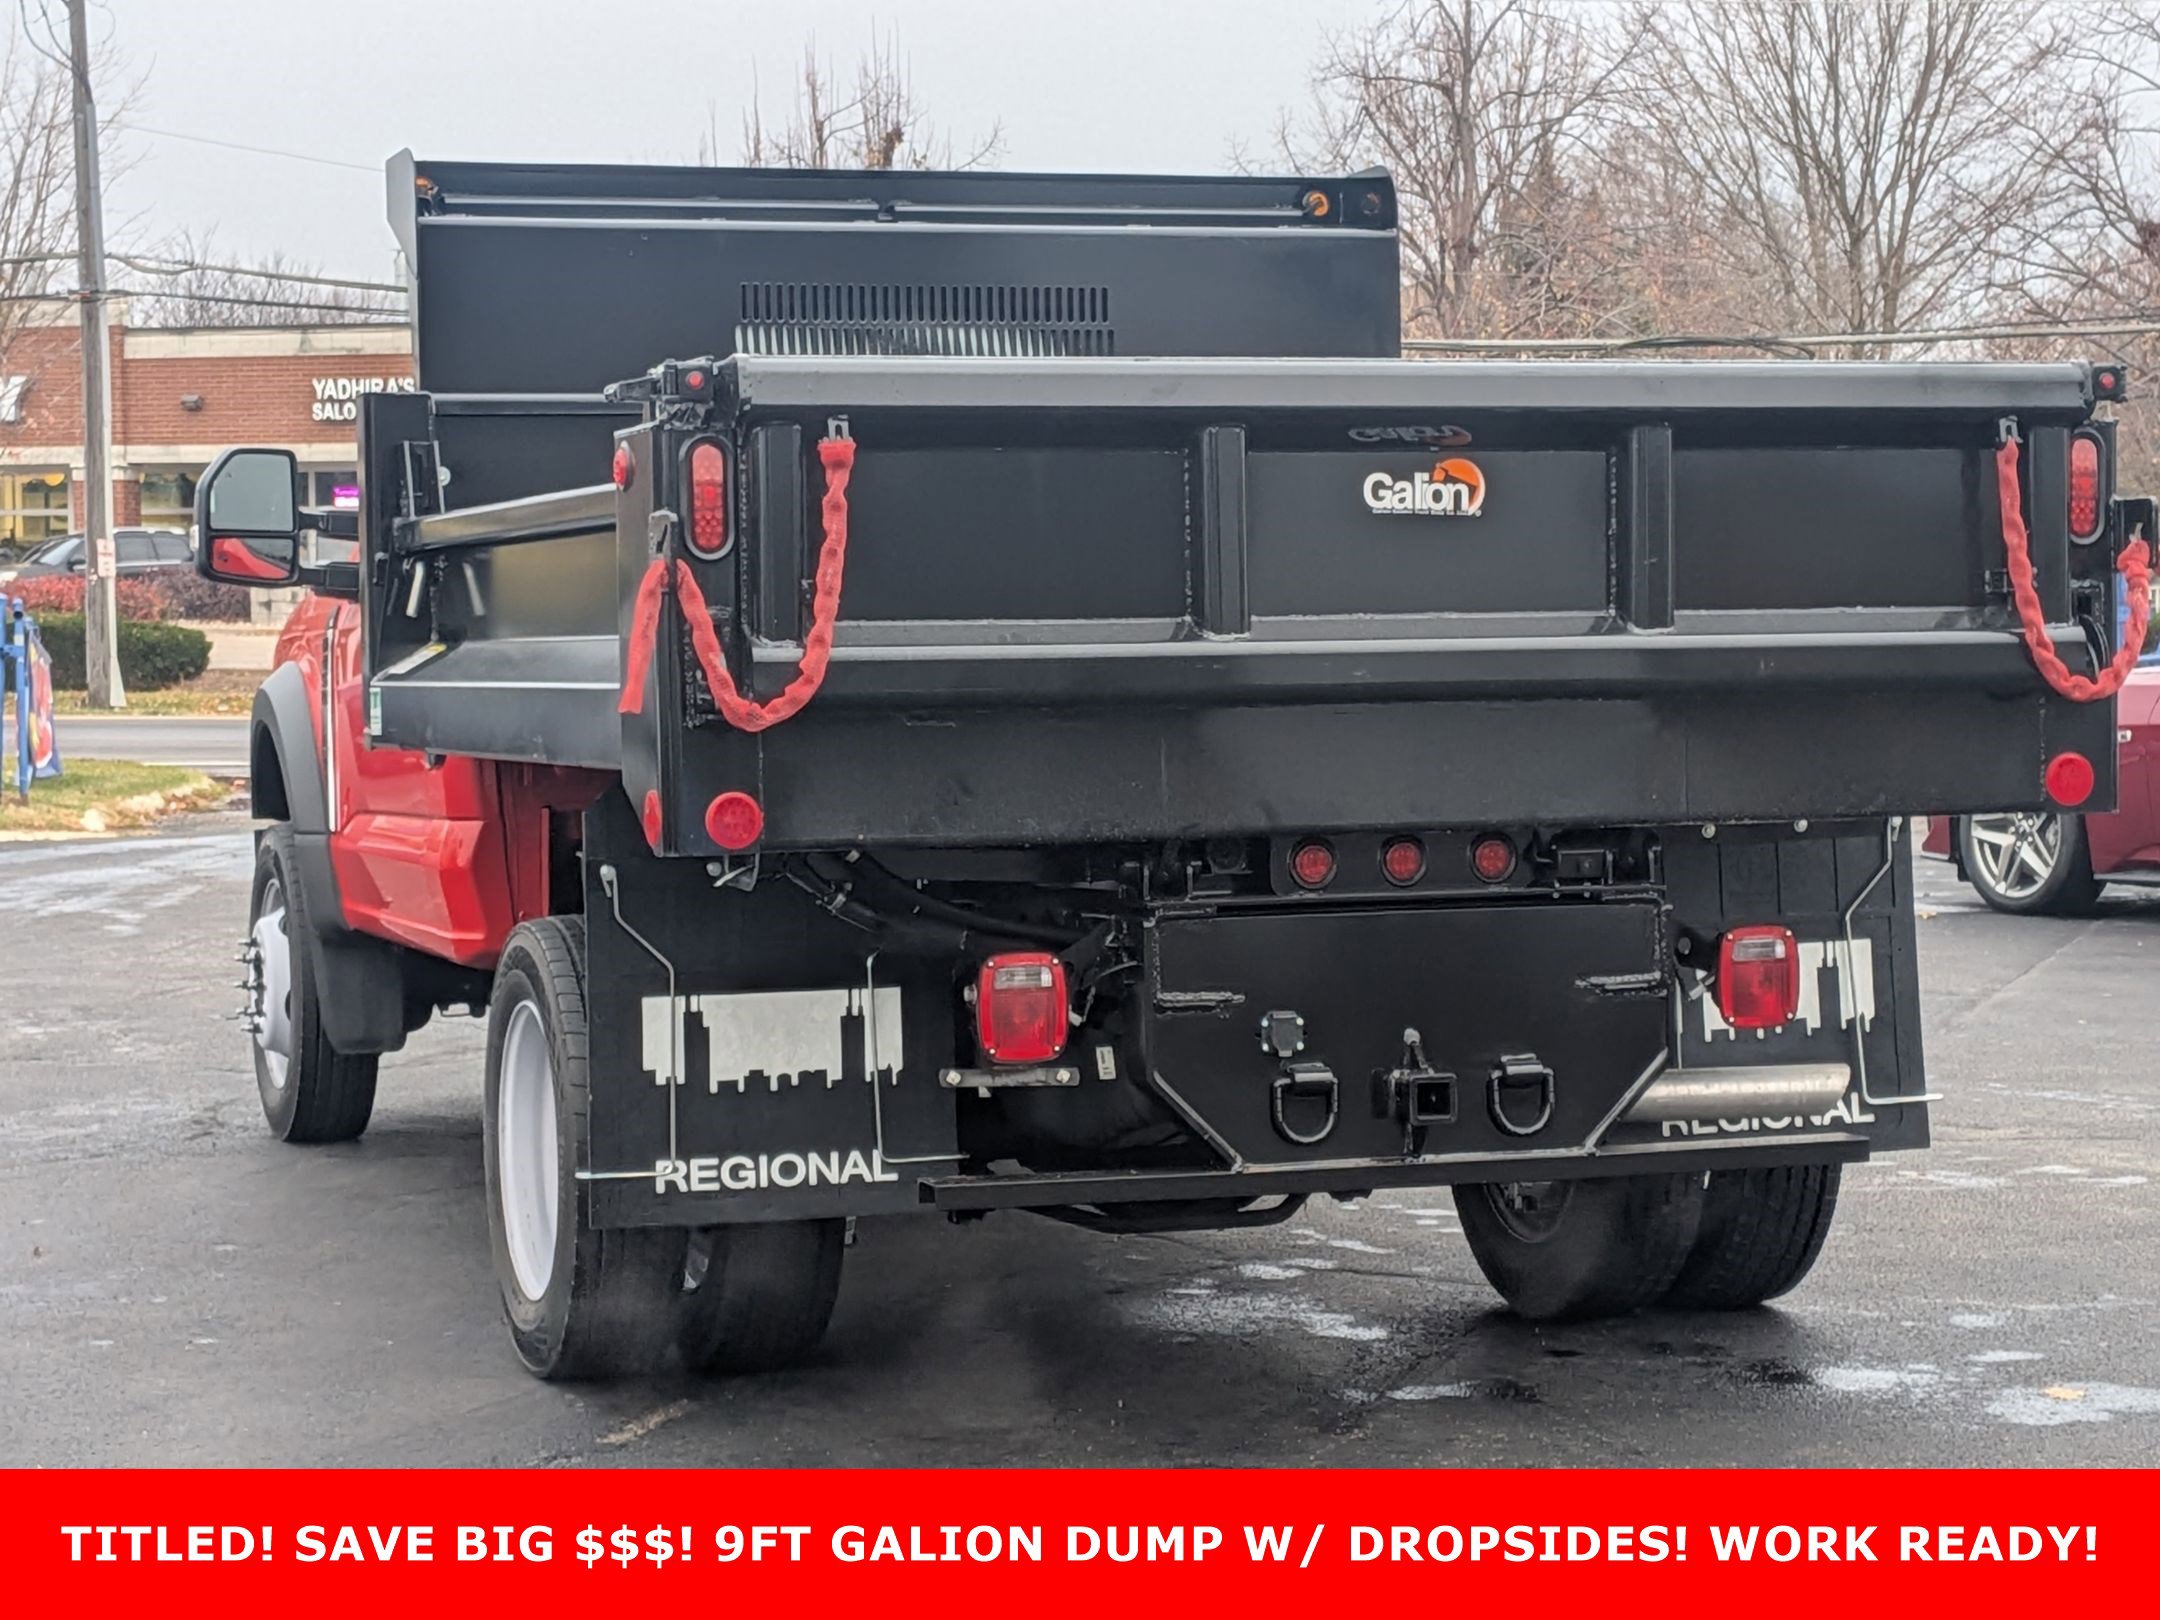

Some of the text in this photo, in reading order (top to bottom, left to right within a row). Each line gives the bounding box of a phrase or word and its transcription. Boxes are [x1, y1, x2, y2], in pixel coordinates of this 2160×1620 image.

[312, 377, 415, 400] YADHIRA'S
[312, 402, 357, 421] SALO
[1363, 472, 1470, 511] Galion
[655, 1148, 899, 1194] REGIONAL
